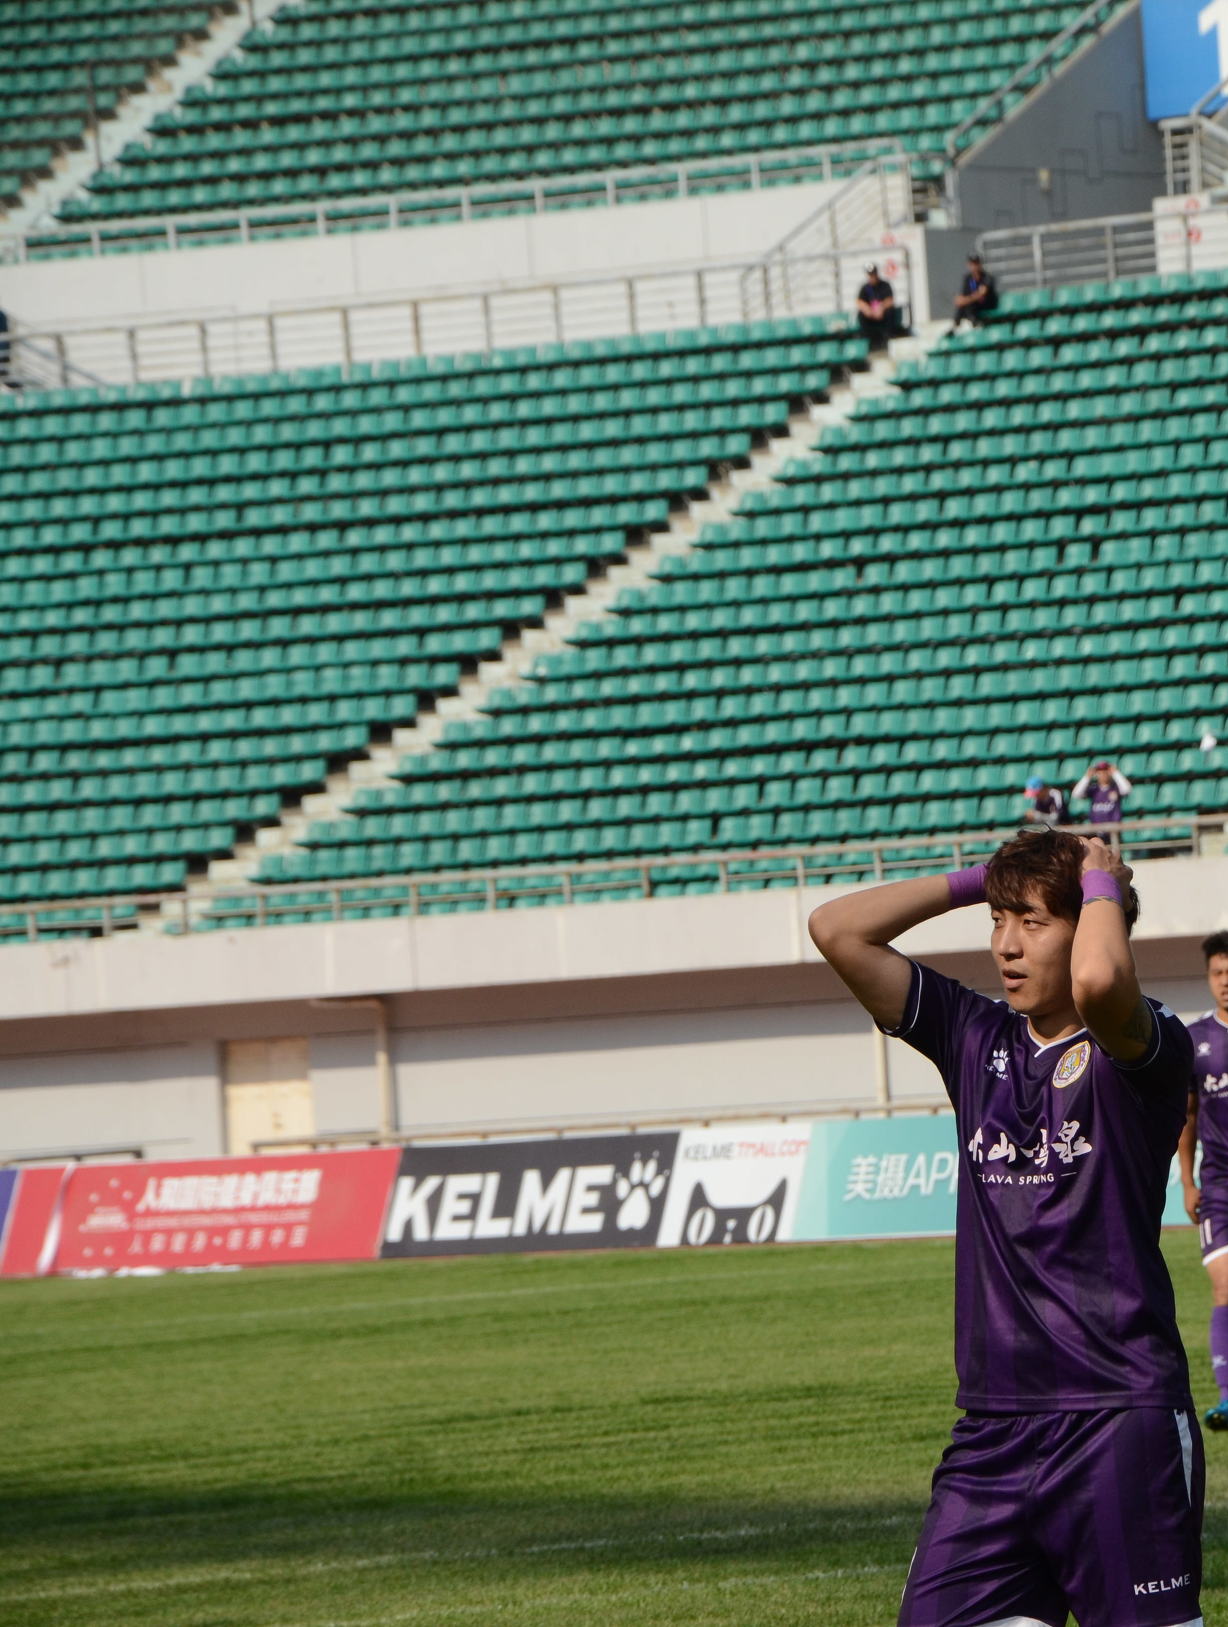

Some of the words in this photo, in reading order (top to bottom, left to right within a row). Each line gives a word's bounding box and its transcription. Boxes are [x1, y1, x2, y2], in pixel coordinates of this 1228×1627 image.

[982, 1173, 1013, 1185] LAVA
[1018, 1172, 1055, 1186] SPRING
[385, 1165, 614, 1242] KELME
[1133, 1573, 1191, 1596] KELME
